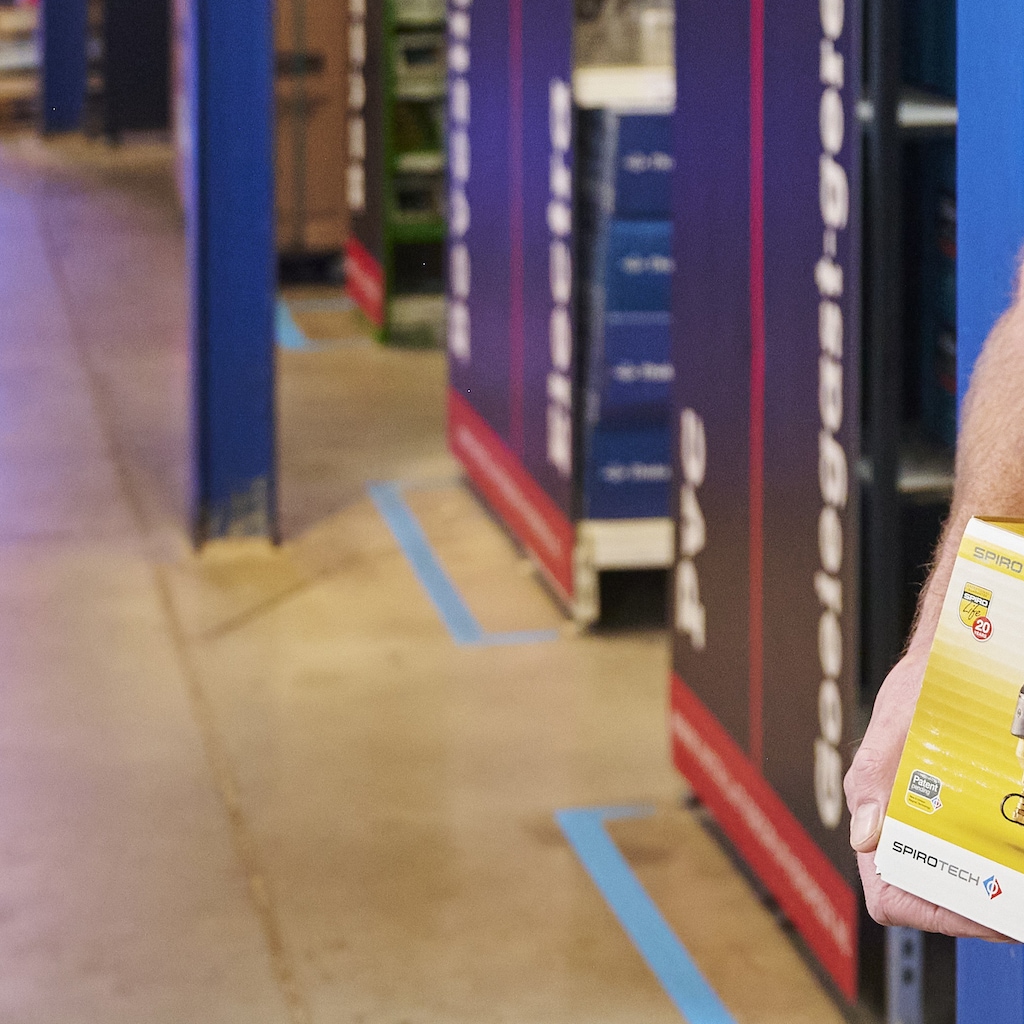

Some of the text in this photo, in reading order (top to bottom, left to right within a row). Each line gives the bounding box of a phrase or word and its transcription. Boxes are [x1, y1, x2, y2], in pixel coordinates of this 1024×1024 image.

[963, 592, 989, 606] SPIRO
[963, 603, 981, 620] Life
[975, 619, 990, 634] 20
[913, 775, 939, 792] Patent
[892, 841, 980, 886] SPIROTECH
